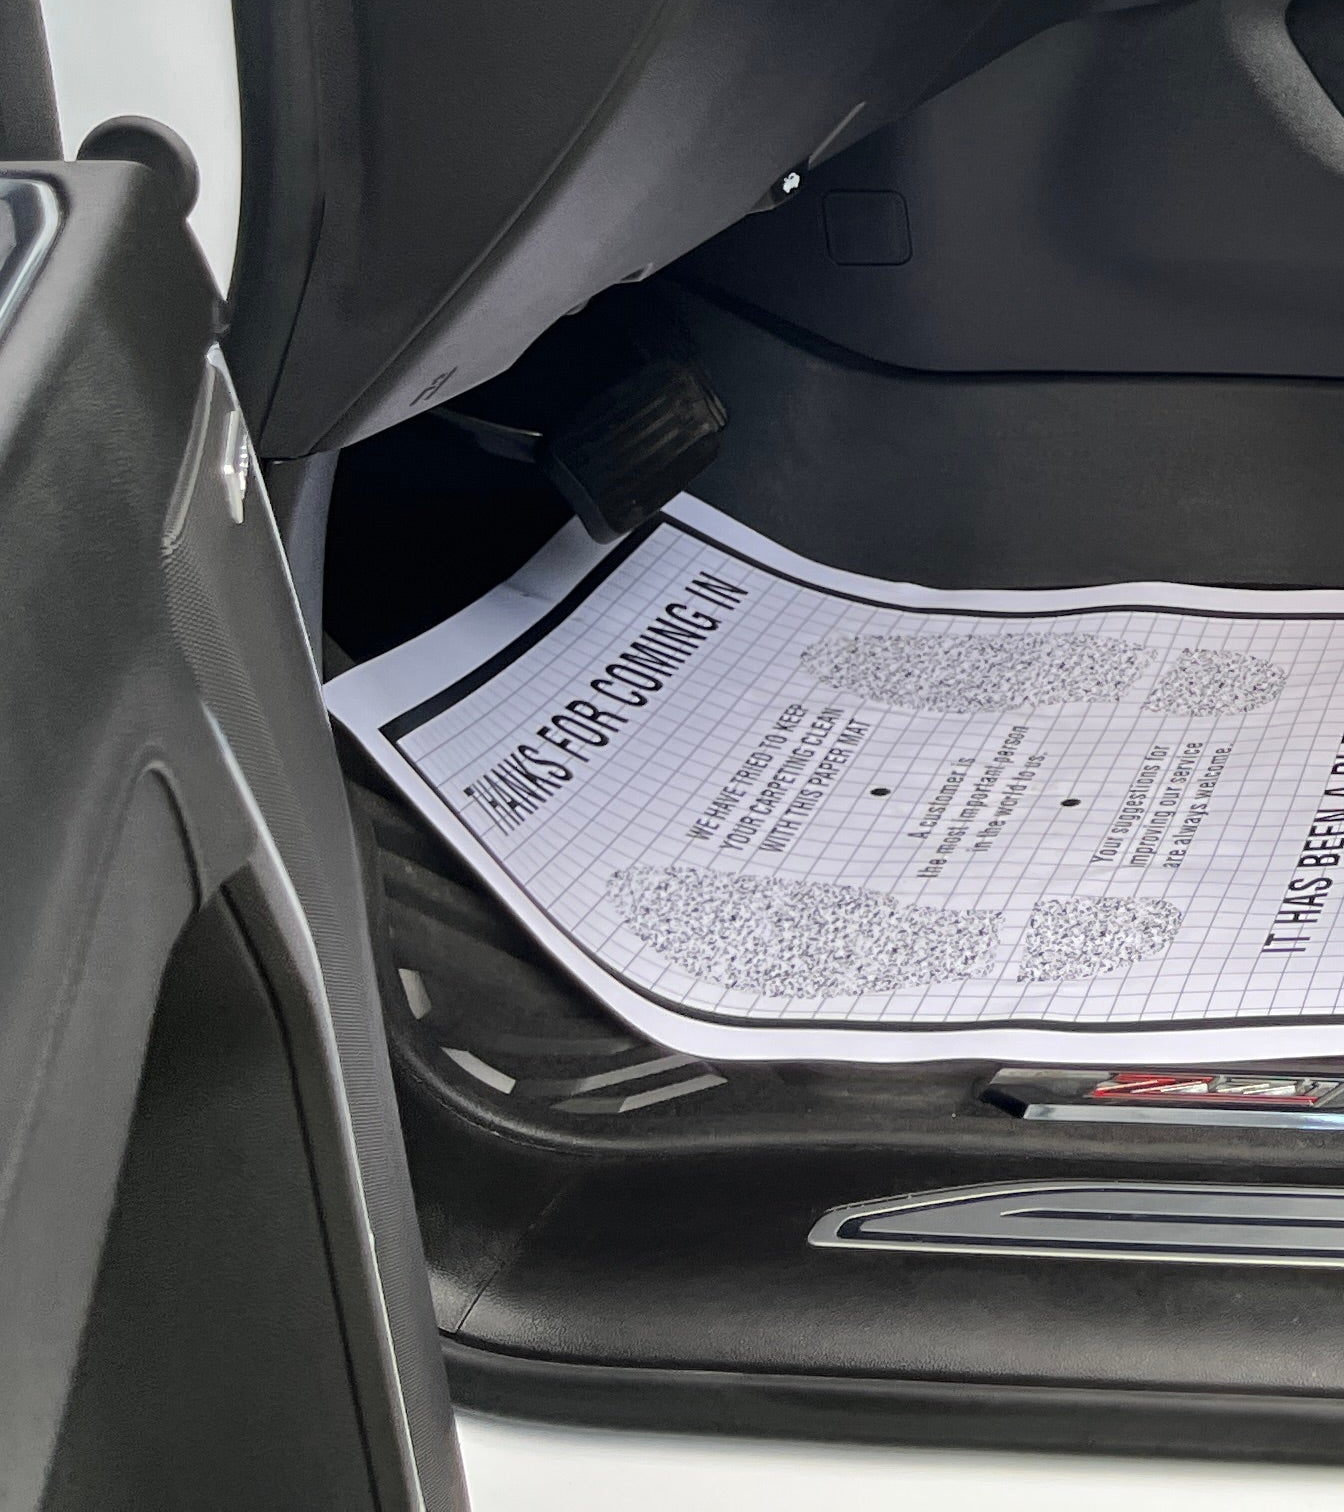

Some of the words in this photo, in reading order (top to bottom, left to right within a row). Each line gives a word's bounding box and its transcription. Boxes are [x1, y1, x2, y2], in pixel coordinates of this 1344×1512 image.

[463, 745, 573, 836] THANKS
[537, 700, 628, 763] FOR
[590, 603, 722, 707] COMING
[685, 571, 748, 610] IN
[994, 725, 1029, 765] person
[1024, 751, 1049, 769] us.
[686, 818, 720, 840] WE
[704, 786, 746, 821] HAVE
[730, 752, 773, 786] TRIED
[758, 734, 787, 750] TO
[773, 703, 808, 732] KEEP
[719, 816, 765, 850] YOUR
[750, 748, 815, 815] CARPETING
[801, 707, 845, 746] CLEAN
[758, 819, 798, 853] WITH
[785, 789, 823, 817] THIS
[808, 747, 853, 787] PAPER
[837, 718, 871, 746] MAT
[1012, 770, 1036, 782] to
[1159, 786, 1182, 807] our
[1171, 742, 1203, 784] service
[1195, 743, 1234, 799] welcome.
[907, 830, 931, 839] A
[919, 770, 967, 827] customer
[951, 757, 976, 768] is
[951, 765, 1005, 823] important
[994, 784, 1028, 817] world
[1089, 836, 1124, 864] Your
[1111, 764, 1160, 834] suggestions
[1144, 745, 1171, 761] for
[936, 826, 969, 854] most
[976, 820, 1006, 838] the
[1172, 803, 1209, 845] always
[966, 841, 993, 852] in
[1163, 849, 1187, 869] are
[916, 858, 947, 878] the
[1274, 876, 1333, 923] HAS
[1261, 934, 1310, 953] IT
